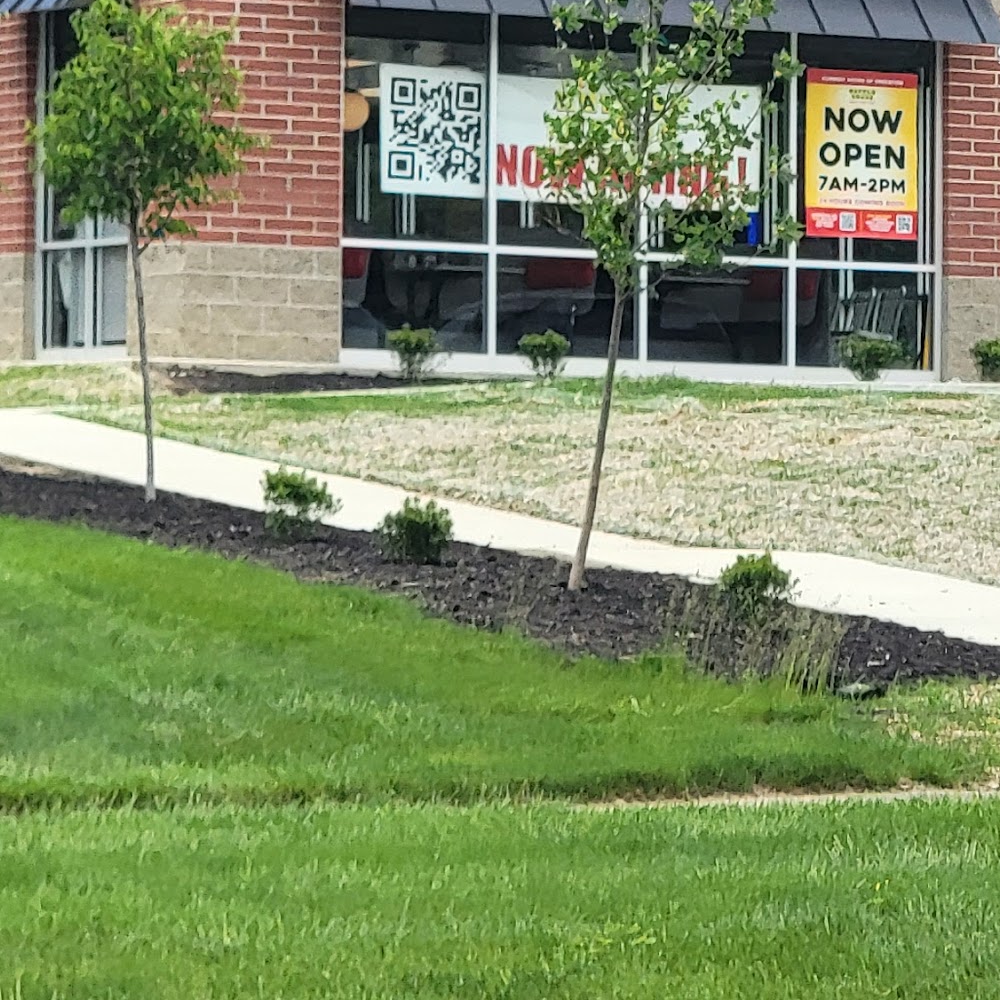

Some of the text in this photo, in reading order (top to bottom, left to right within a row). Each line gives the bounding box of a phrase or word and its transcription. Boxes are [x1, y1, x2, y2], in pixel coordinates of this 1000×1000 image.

[824, 106, 903, 134] NOW
[819, 141, 906, 169] OPEN
[818, 175, 906, 194] 7AM-2PM
